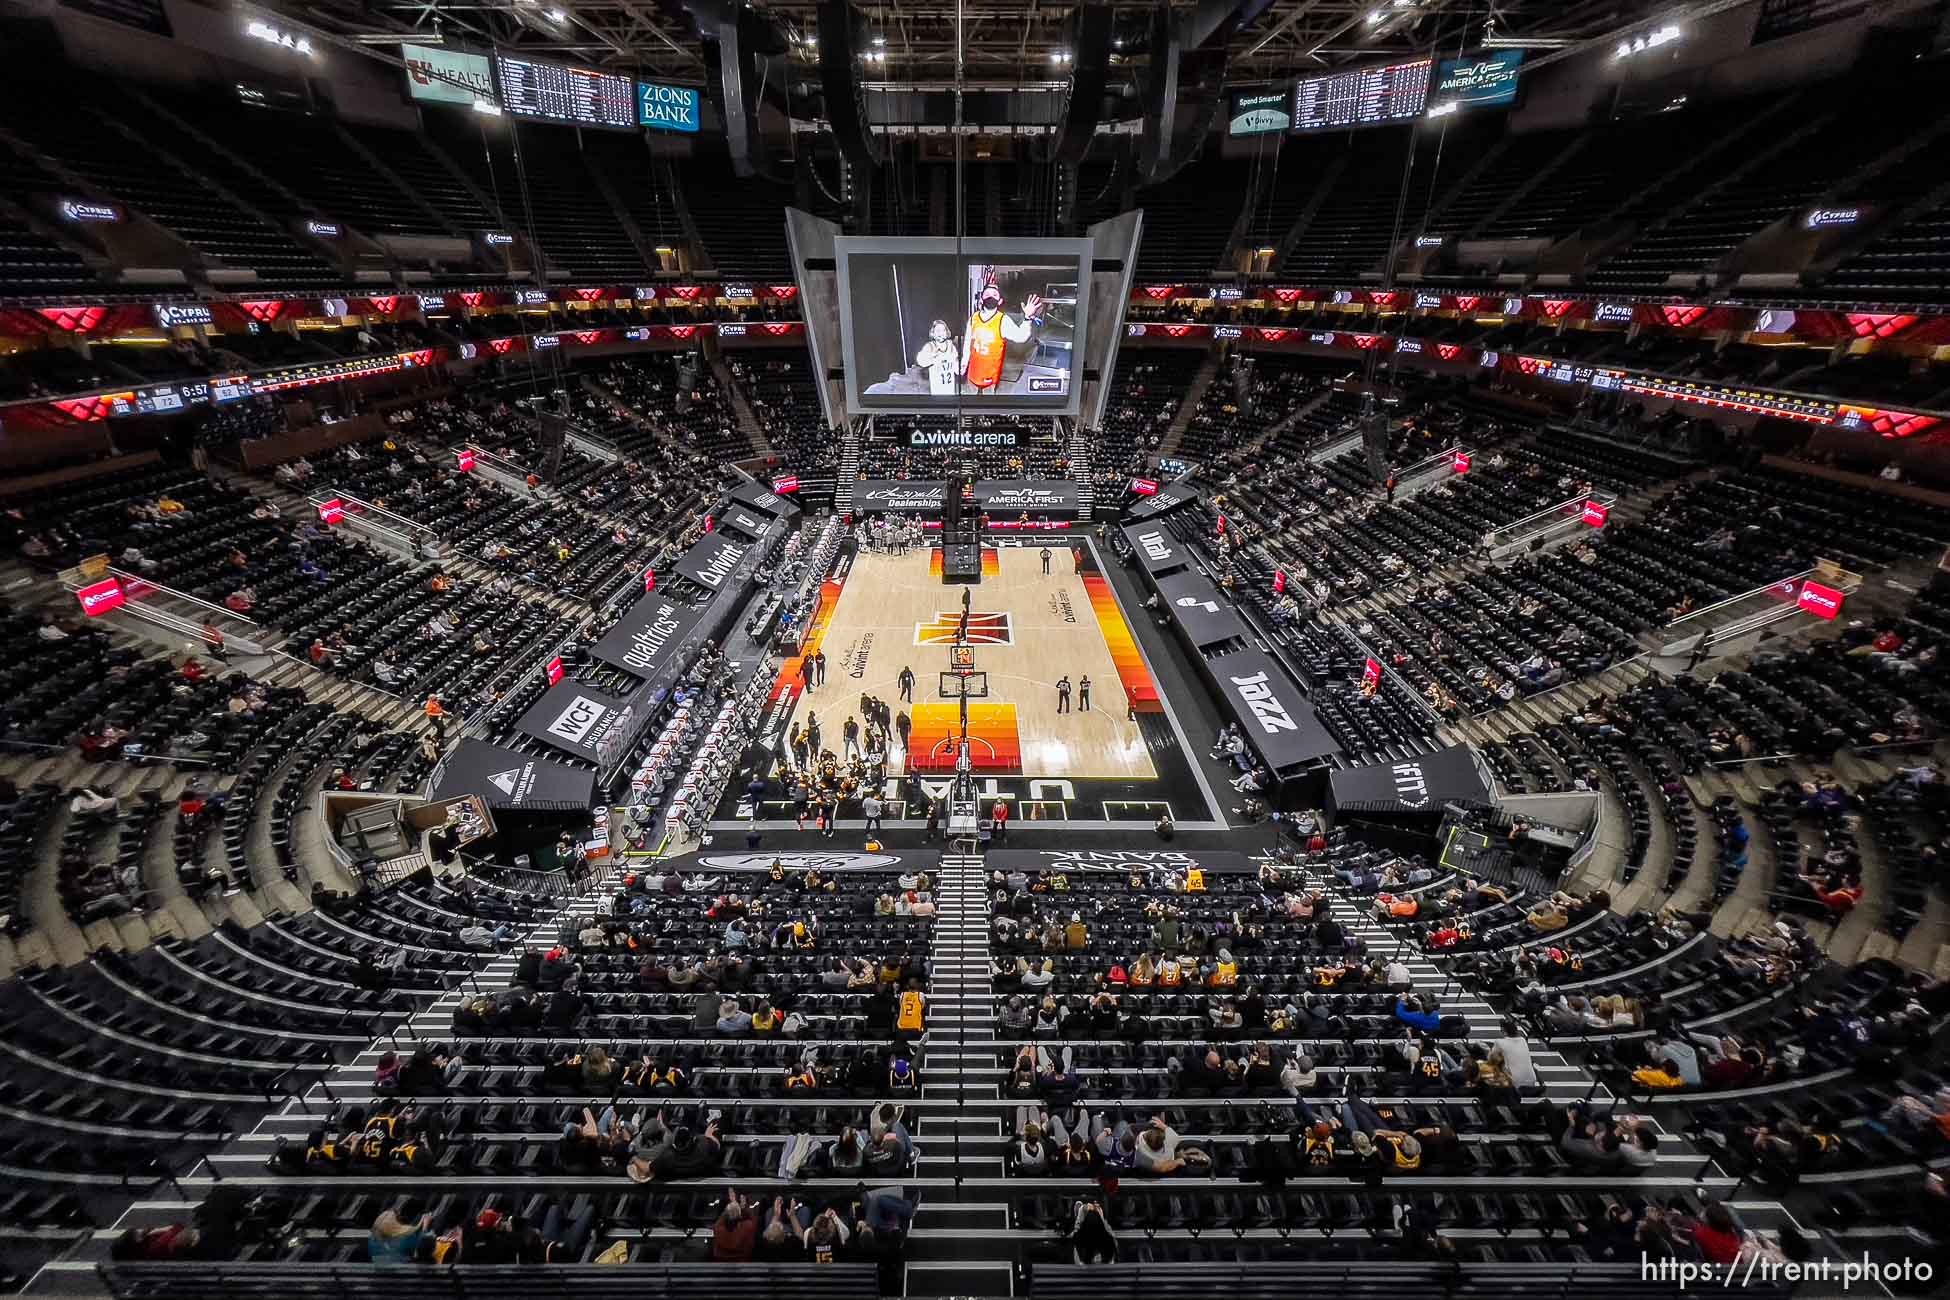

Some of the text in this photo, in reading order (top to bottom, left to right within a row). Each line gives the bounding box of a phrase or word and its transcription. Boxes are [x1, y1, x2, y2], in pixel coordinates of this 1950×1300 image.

[1440, 75, 1484, 89] AMERICA
[642, 86, 692, 106] ZIONS
[1240, 96, 1258, 107] Spend
[644, 102, 691, 124] BANK
[941, 372, 952, 384] 12
[1574, 367, 1593, 378] 6:57
[183, 384, 207, 397] 6:57
[927, 430, 1015, 444] vivint arena
[888, 499, 942, 508] Dealerships
[707, 544, 744, 576] vivint
[855, 650, 869, 671] vivint
[1230, 671, 1298, 733] Jazz
[557, 702, 595, 735] WCF
[582, 708, 619, 749] INSURANCE
[1040, 851, 1190, 861] BANK
[906, 1003, 914, 1017] 2
[1423, 1062, 1440, 1077] 45
[363, 1141, 382, 1158] 45
